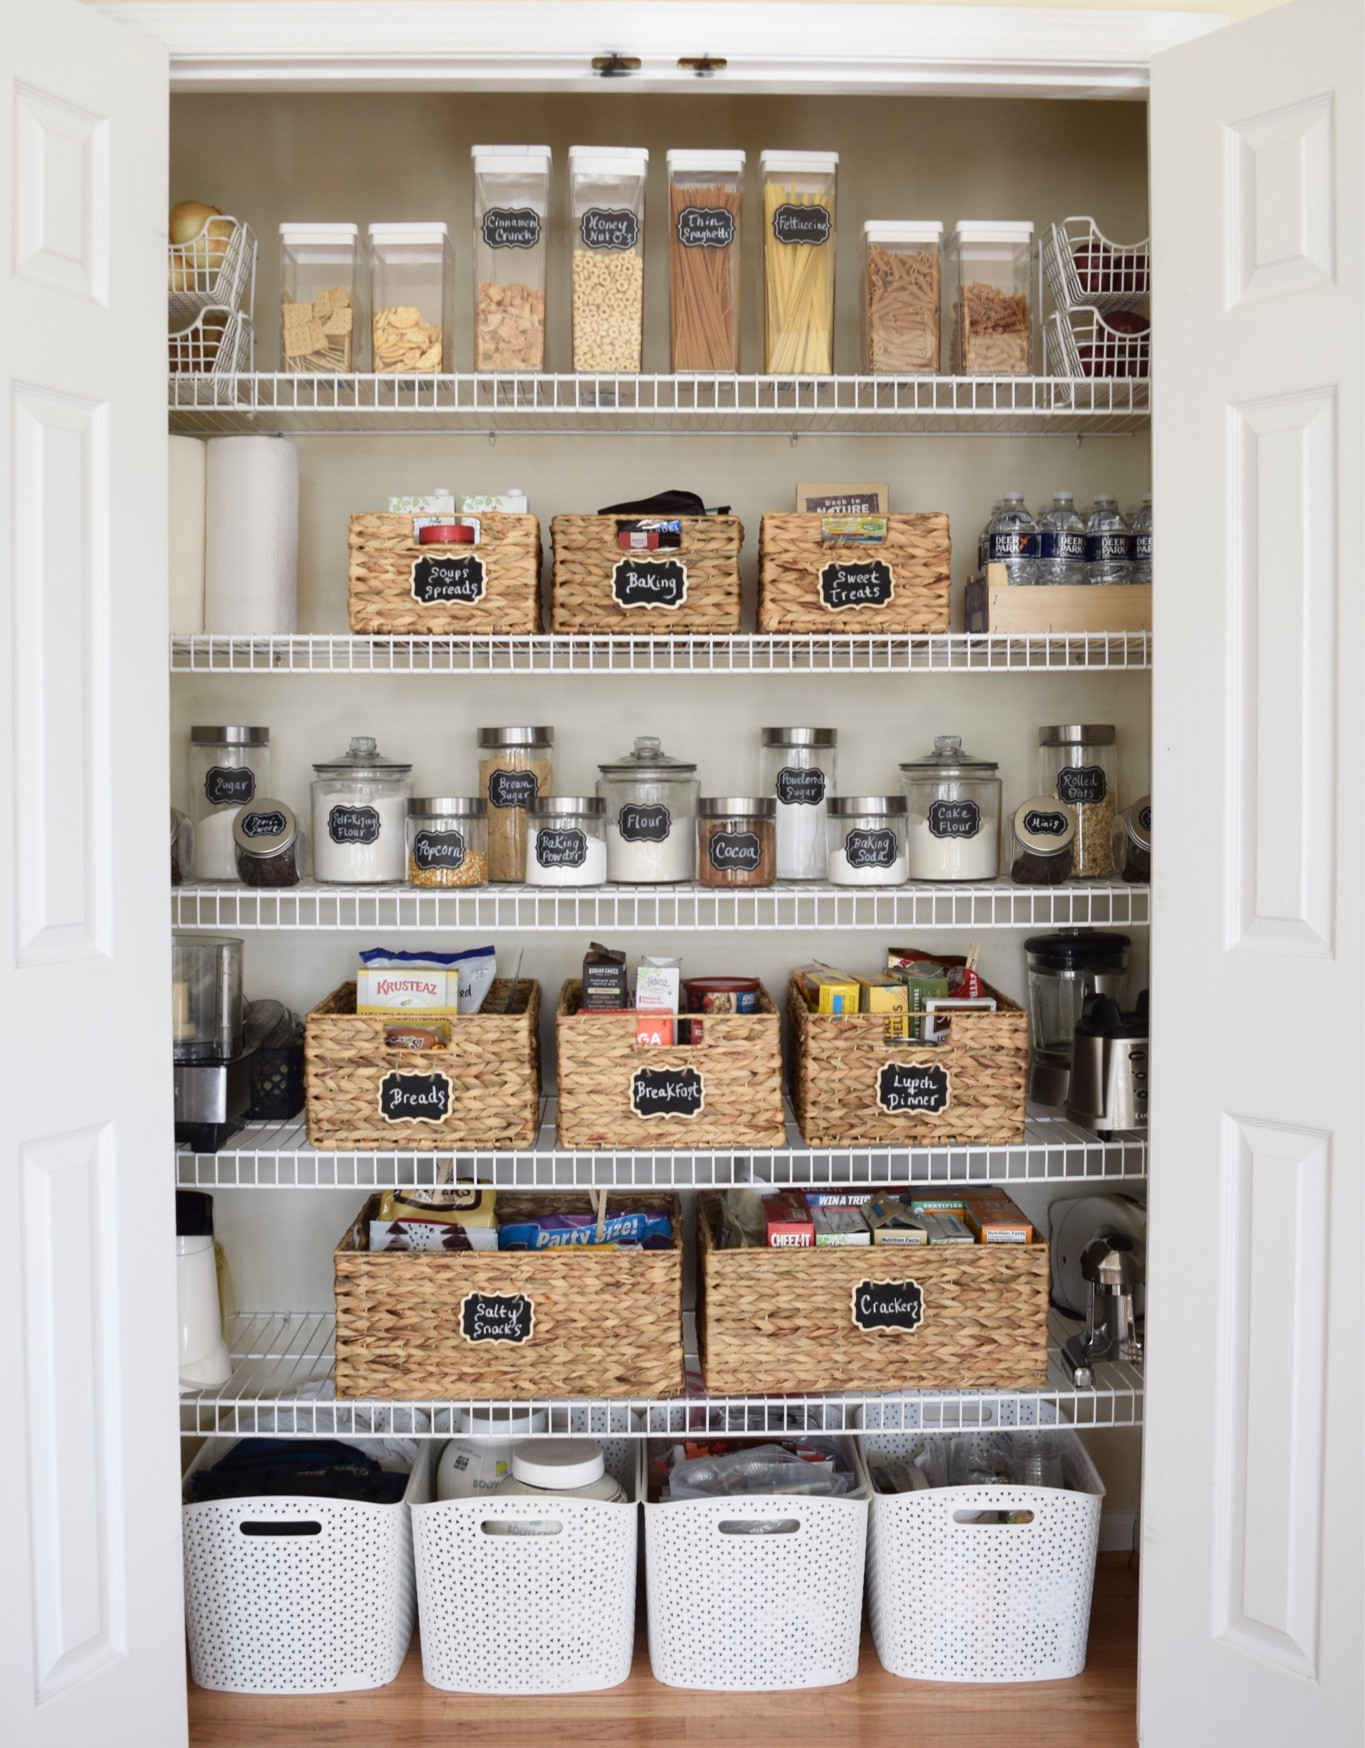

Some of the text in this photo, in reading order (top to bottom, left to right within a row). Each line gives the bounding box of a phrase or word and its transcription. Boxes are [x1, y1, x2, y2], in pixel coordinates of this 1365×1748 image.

[487, 215, 537, 228] Cinnamon
[589, 215, 627, 232] Honey
[688, 214, 725, 227] Thin
[779, 215, 829, 231] Fettuccine
[495, 229, 537, 242] Crunch
[589, 231, 610, 242] Nut
[683, 226, 730, 243] Spaghetti
[824, 499, 847, 507] back
[995, 536, 1020, 545] DEER
[1060, 537, 1083, 546] DEER
[1101, 538, 1126, 546] DEER
[995, 544, 1020, 553] PARK
[1060, 545, 1083, 554] PARK
[1101, 546, 1126, 554] PARK
[429, 567, 469, 584] Soups
[832, 570, 881, 589] Sweet
[829, 585, 881, 604] Treats
[498, 777, 534, 790] Brown
[781, 774, 824, 786] Powdered
[1062, 773, 1098, 786] Rolled
[214, 778, 249, 795] Sugar
[786, 786, 818, 799] Sugar
[1067, 787, 1095, 798] Oats
[497, 789, 530, 802] Sugar
[937, 807, 972, 819] Cake
[627, 813, 663, 830] Flour
[938, 820, 973, 832] Flour
[338, 828, 366, 838] Flour
[418, 839, 464, 861] Popcorn
[541, 850, 583, 863] Powder
[715, 842, 759, 860] Cocoa
[856, 850, 888, 864] Soda
[376, 979, 438, 996] KRUSTEAZ
[893, 1074, 939, 1089] Lunch
[389, 1085, 445, 1110] Breads
[888, 1093, 940, 1111] Dinner
[818, 1195, 839, 1206] WIN
[838, 1195, 846, 1206] A
[536, 1228, 591, 1249] Party
[475, 1299, 525, 1326] Salty
[861, 1294, 920, 1320] Crackers
[473, 1321, 523, 1339] Snacks
